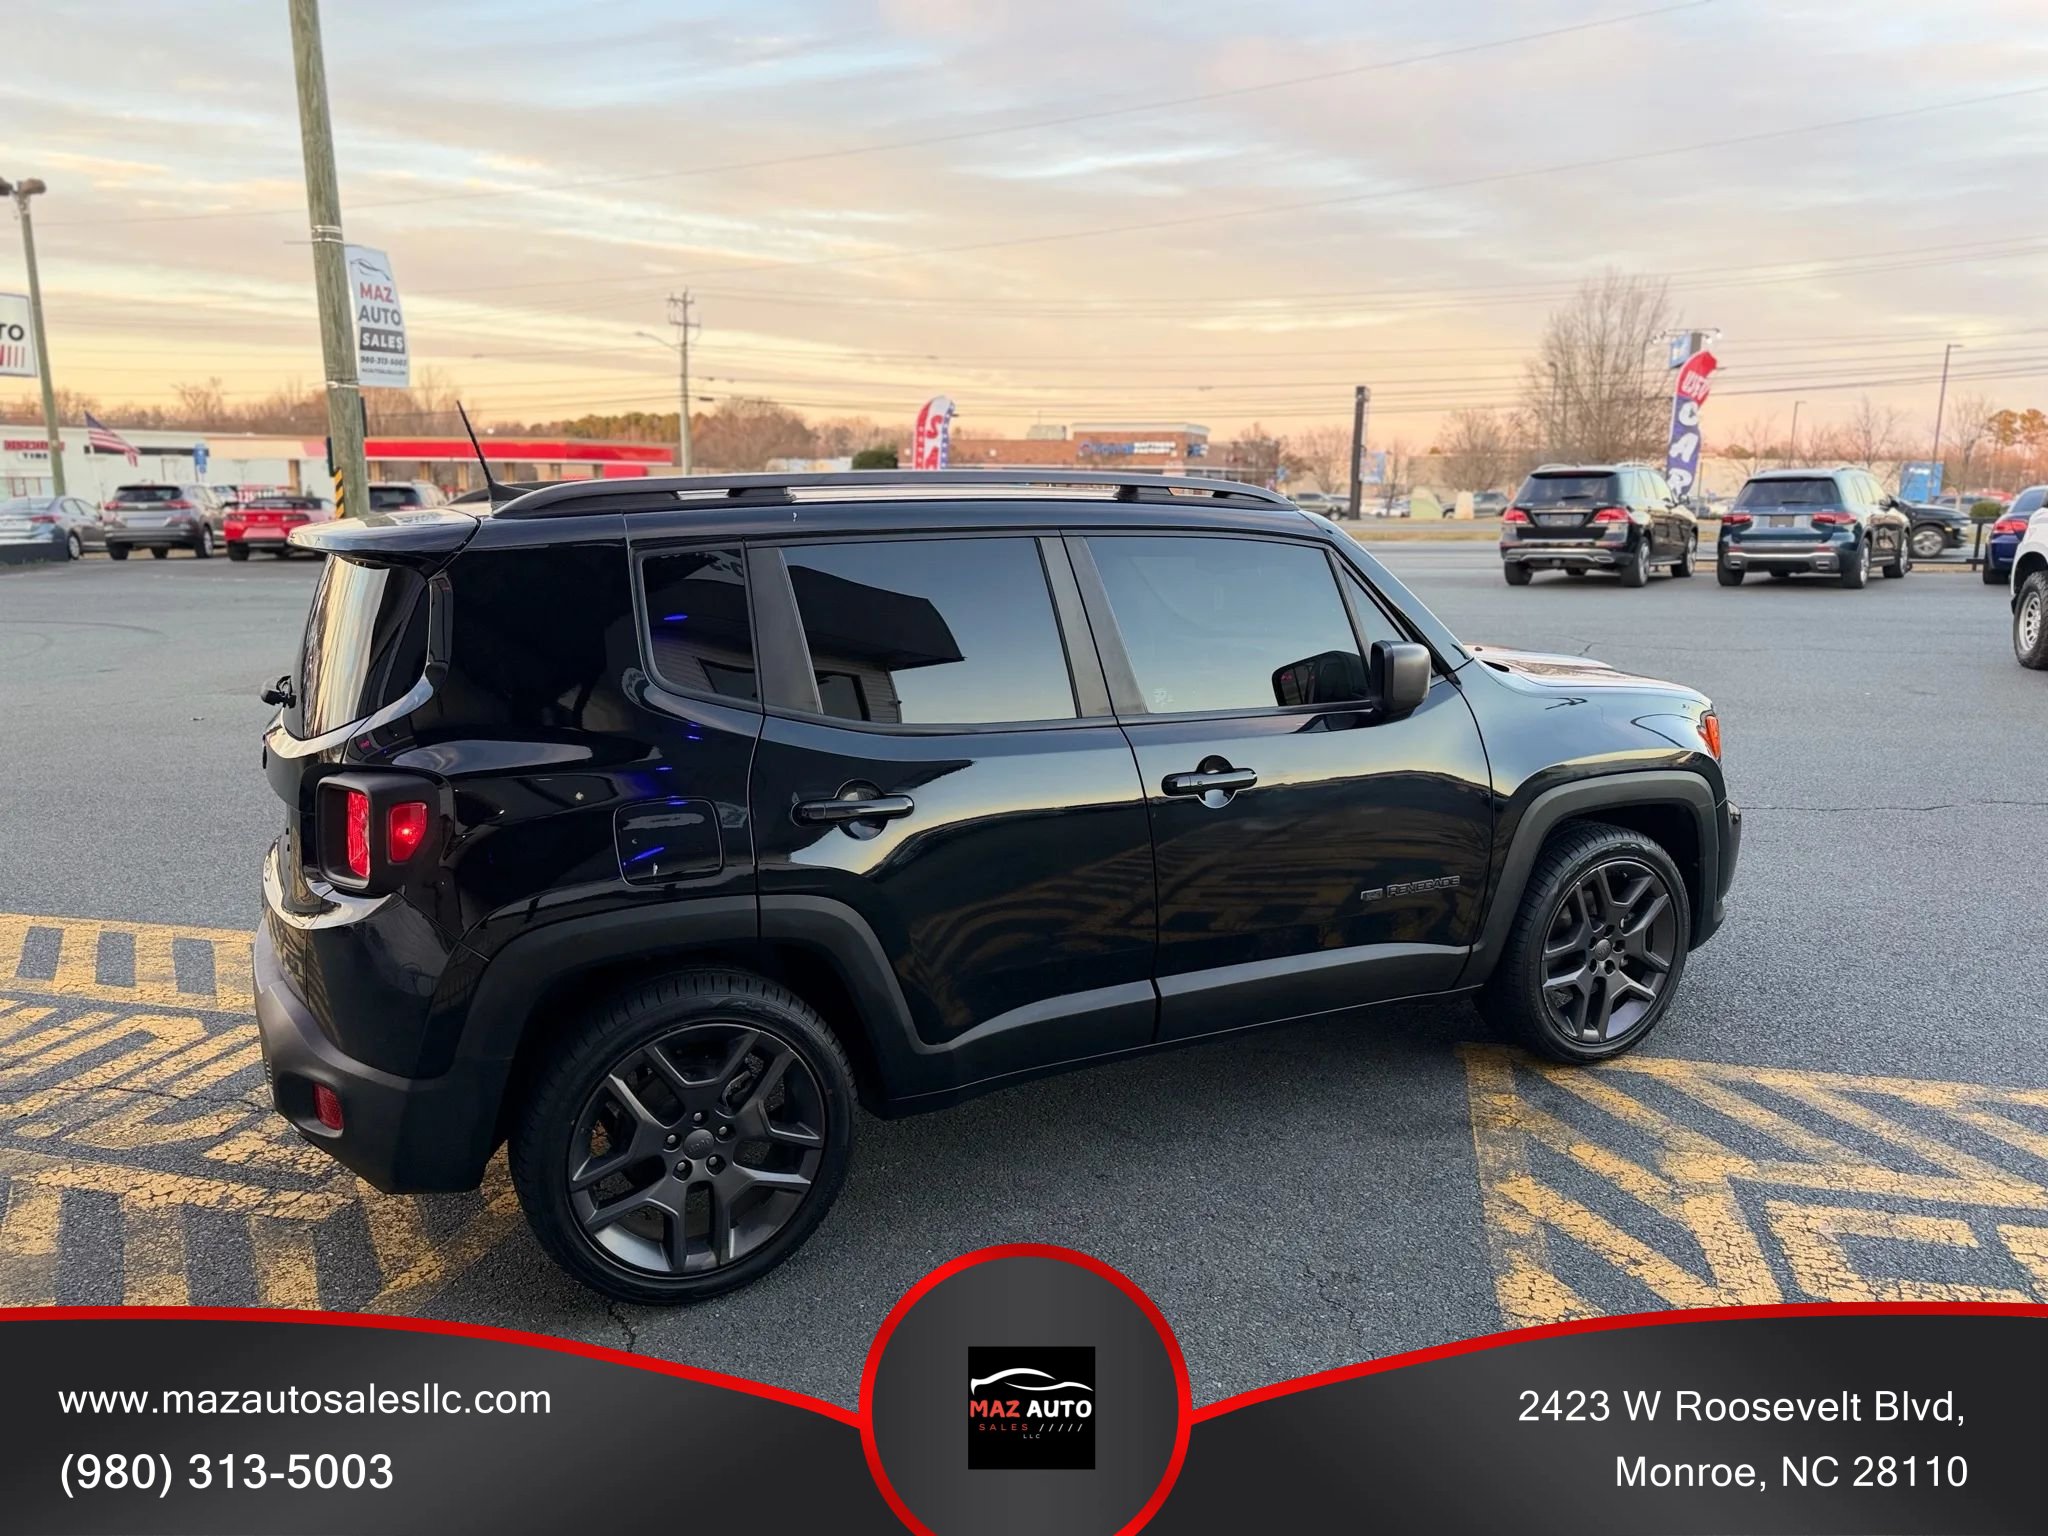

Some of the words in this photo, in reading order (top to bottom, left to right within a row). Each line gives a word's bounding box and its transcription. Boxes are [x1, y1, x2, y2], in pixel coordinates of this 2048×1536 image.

[360, 282, 394, 304] MAZ
[358, 304, 403, 326] AUTO
[362, 332, 404, 351] SALES
[1387, 875, 1460, 898] RENEGADE
